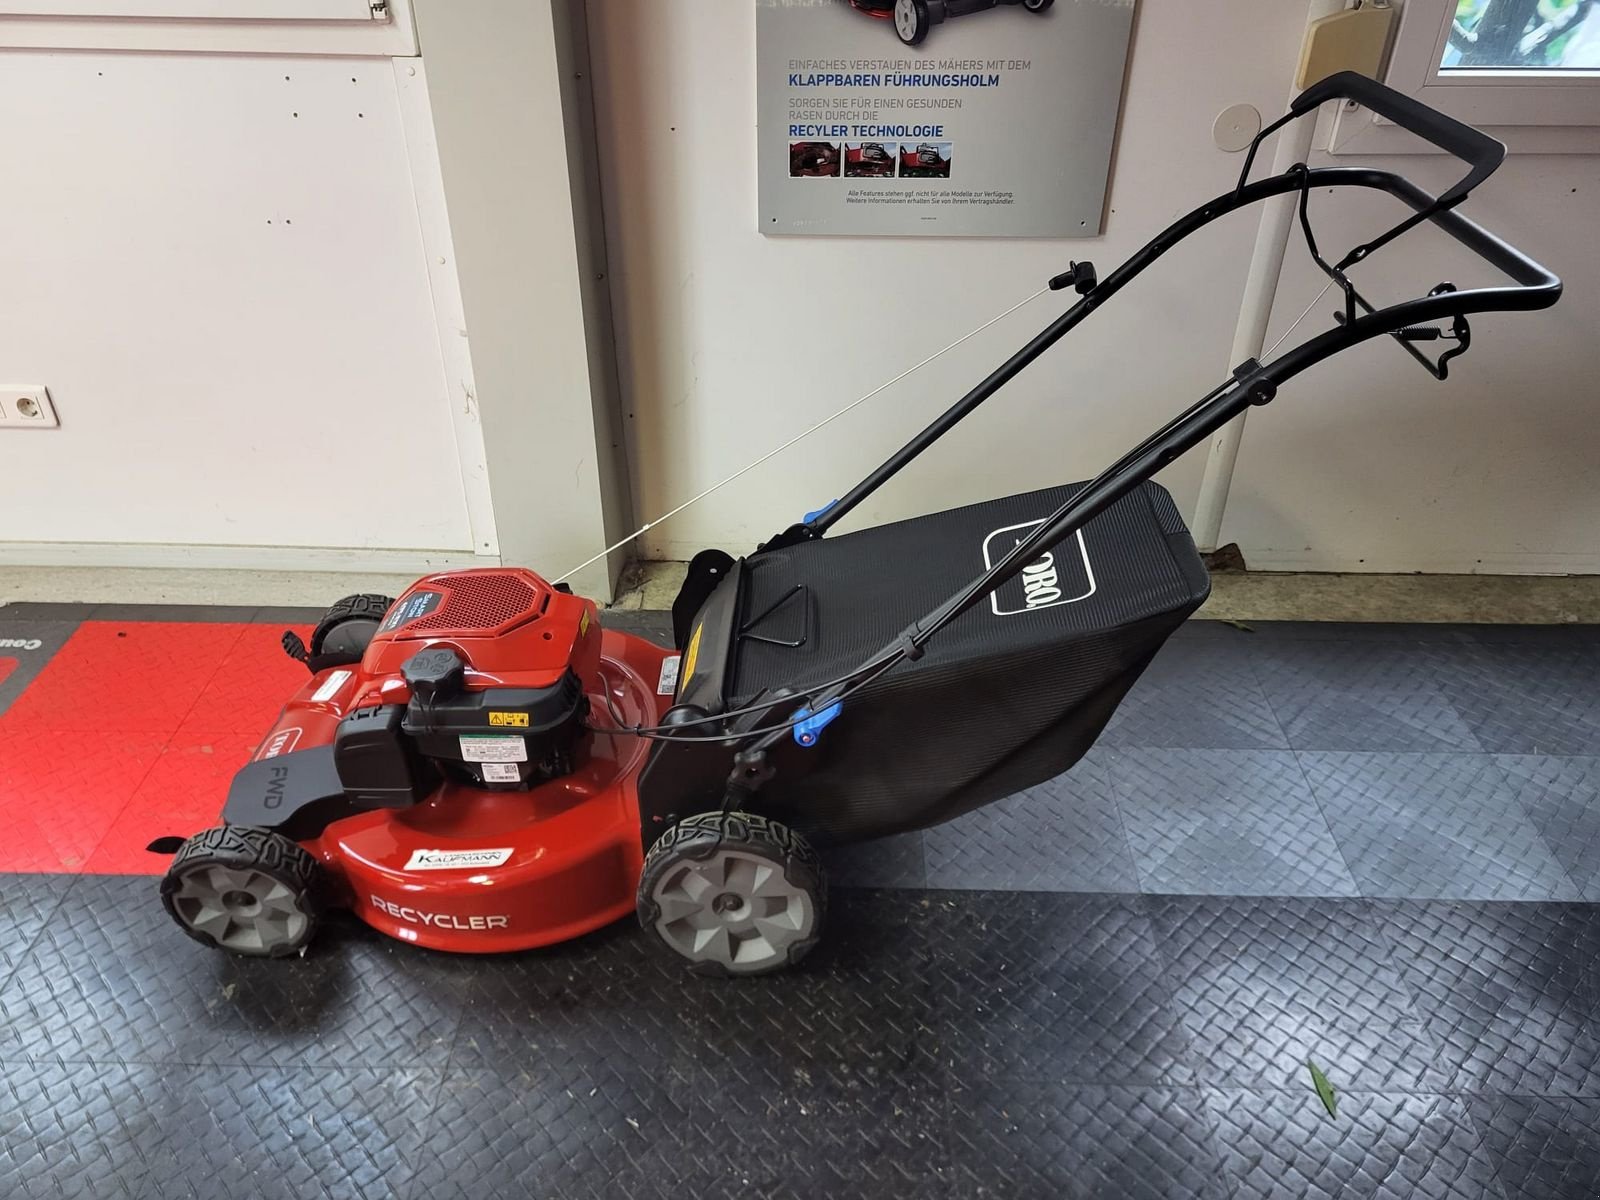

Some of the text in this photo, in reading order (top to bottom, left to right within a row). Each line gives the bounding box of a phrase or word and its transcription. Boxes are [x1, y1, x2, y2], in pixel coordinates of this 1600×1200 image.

[788, 58, 1032, 71] EINFACHES VERSTAUEN DES MÄHERS MIT DEM
[788, 71, 1000, 88] KLAPPBAREN FÜHRUNGSHOLM
[788, 96, 963, 109] SORGEN SIE FÜR EINEN GESUNDEN
[788, 110, 879, 121] RASEN DURCH DIE
[788, 124, 944, 138] RECYLER TECHNOLOGIE
[951, 190, 973, 198] Modelle
[1016, 539, 1062, 604] ORO
[263, 766, 289, 810] FWD
[370, 894, 508, 930] RECYCLER
